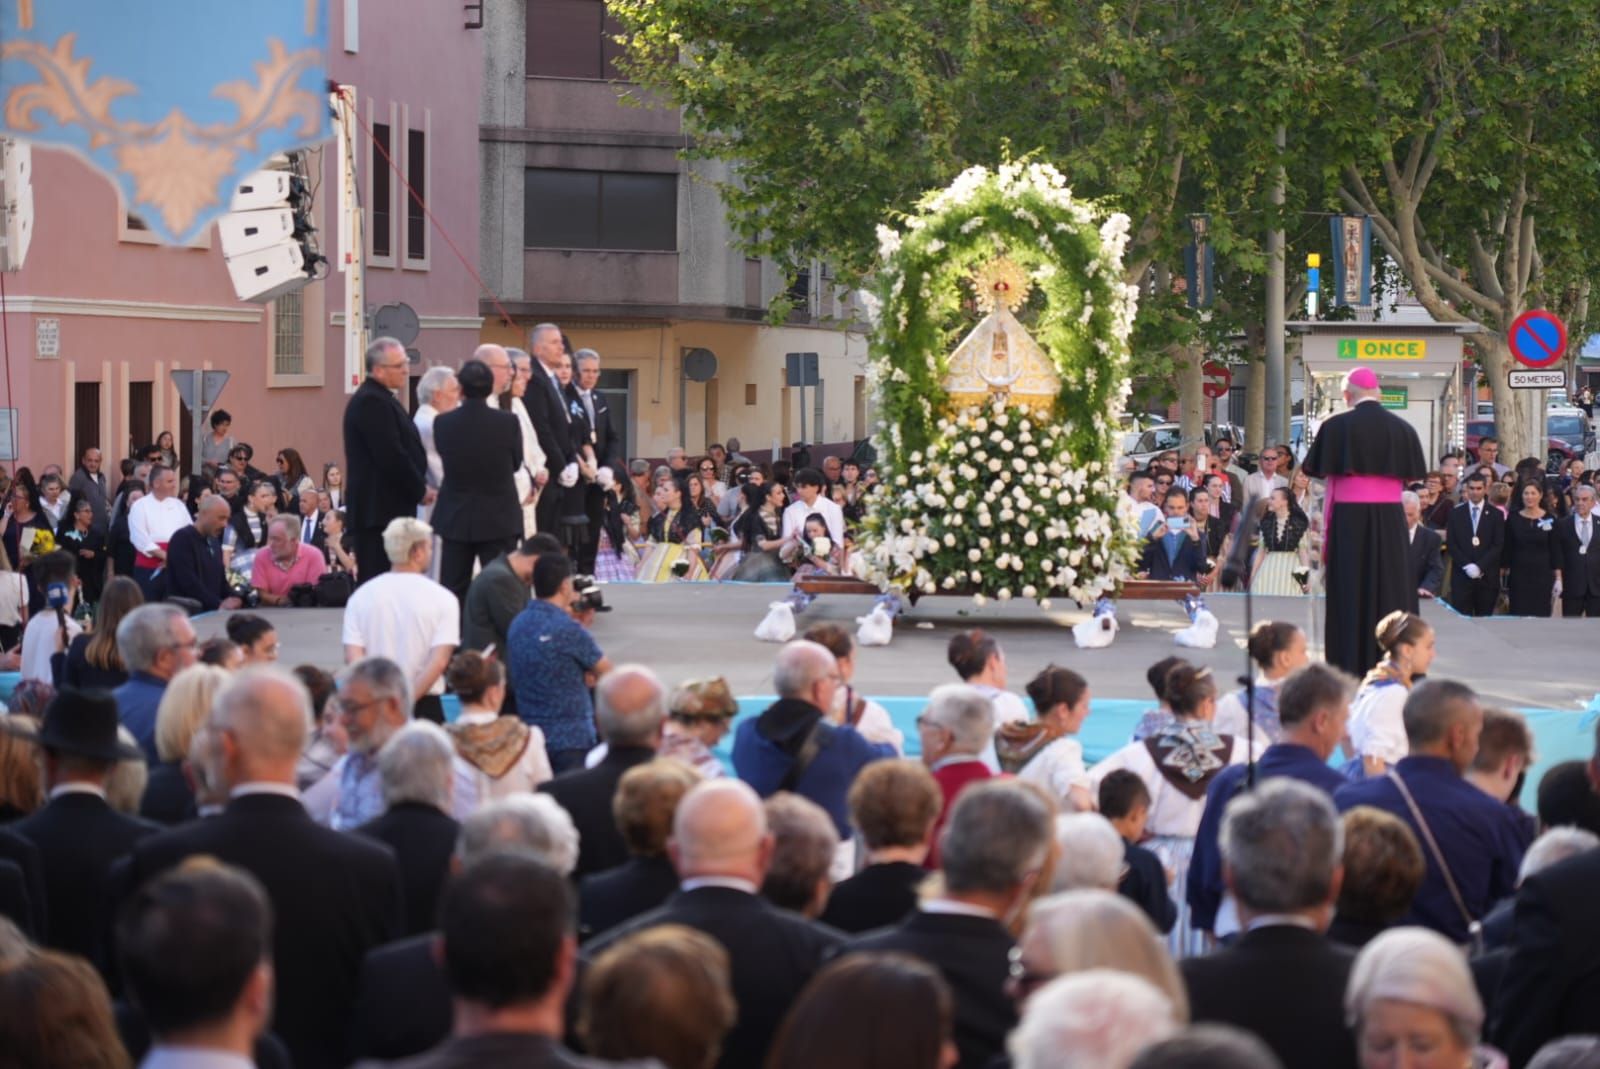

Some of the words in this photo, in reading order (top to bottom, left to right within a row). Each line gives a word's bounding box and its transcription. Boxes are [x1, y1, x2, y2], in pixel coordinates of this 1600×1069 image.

[1364, 342, 1419, 356] ONCE
[1514, 375, 1526, 384] 50
[1527, 375, 1562, 384] METROS
